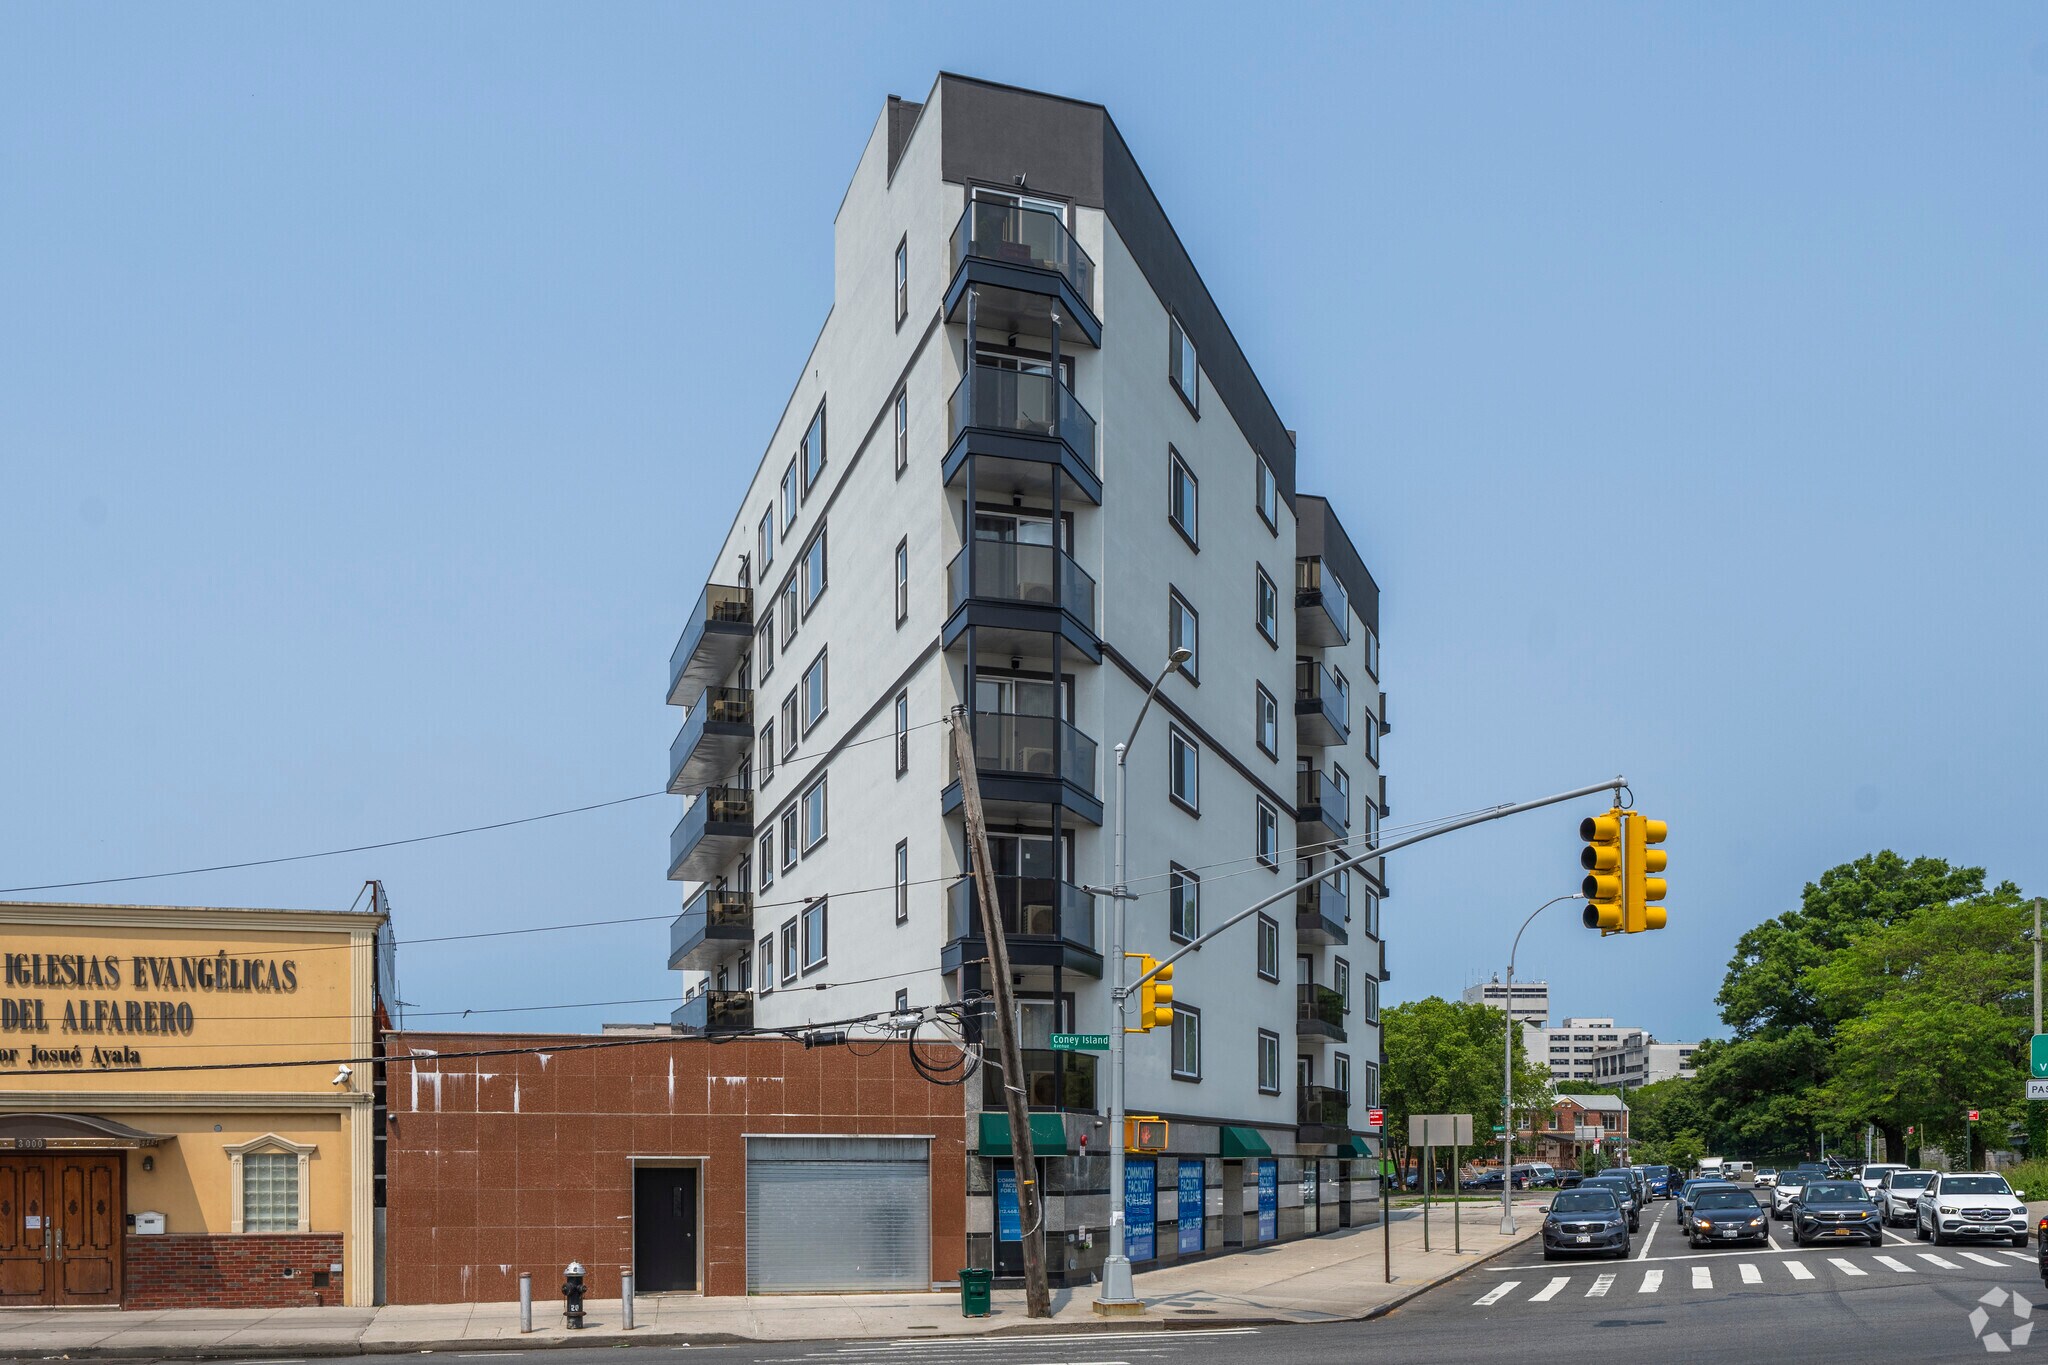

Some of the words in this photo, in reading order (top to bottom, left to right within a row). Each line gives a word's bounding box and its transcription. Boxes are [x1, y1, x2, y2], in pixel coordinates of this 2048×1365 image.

[5, 953, 120, 986] IGLESIAS
[131, 949, 297, 990] EVANGÉLICAS
[0, 998, 48, 1030] DEL
[61, 999, 194, 1032] ALFARERO
[1053, 1035, 1079, 1046] Coney
[1082, 1036, 1109, 1045] Island
[27, 1044, 82, 1064] Josué
[90, 1045, 141, 1068] Ayala
[18, 1138, 43, 1149] 3000
